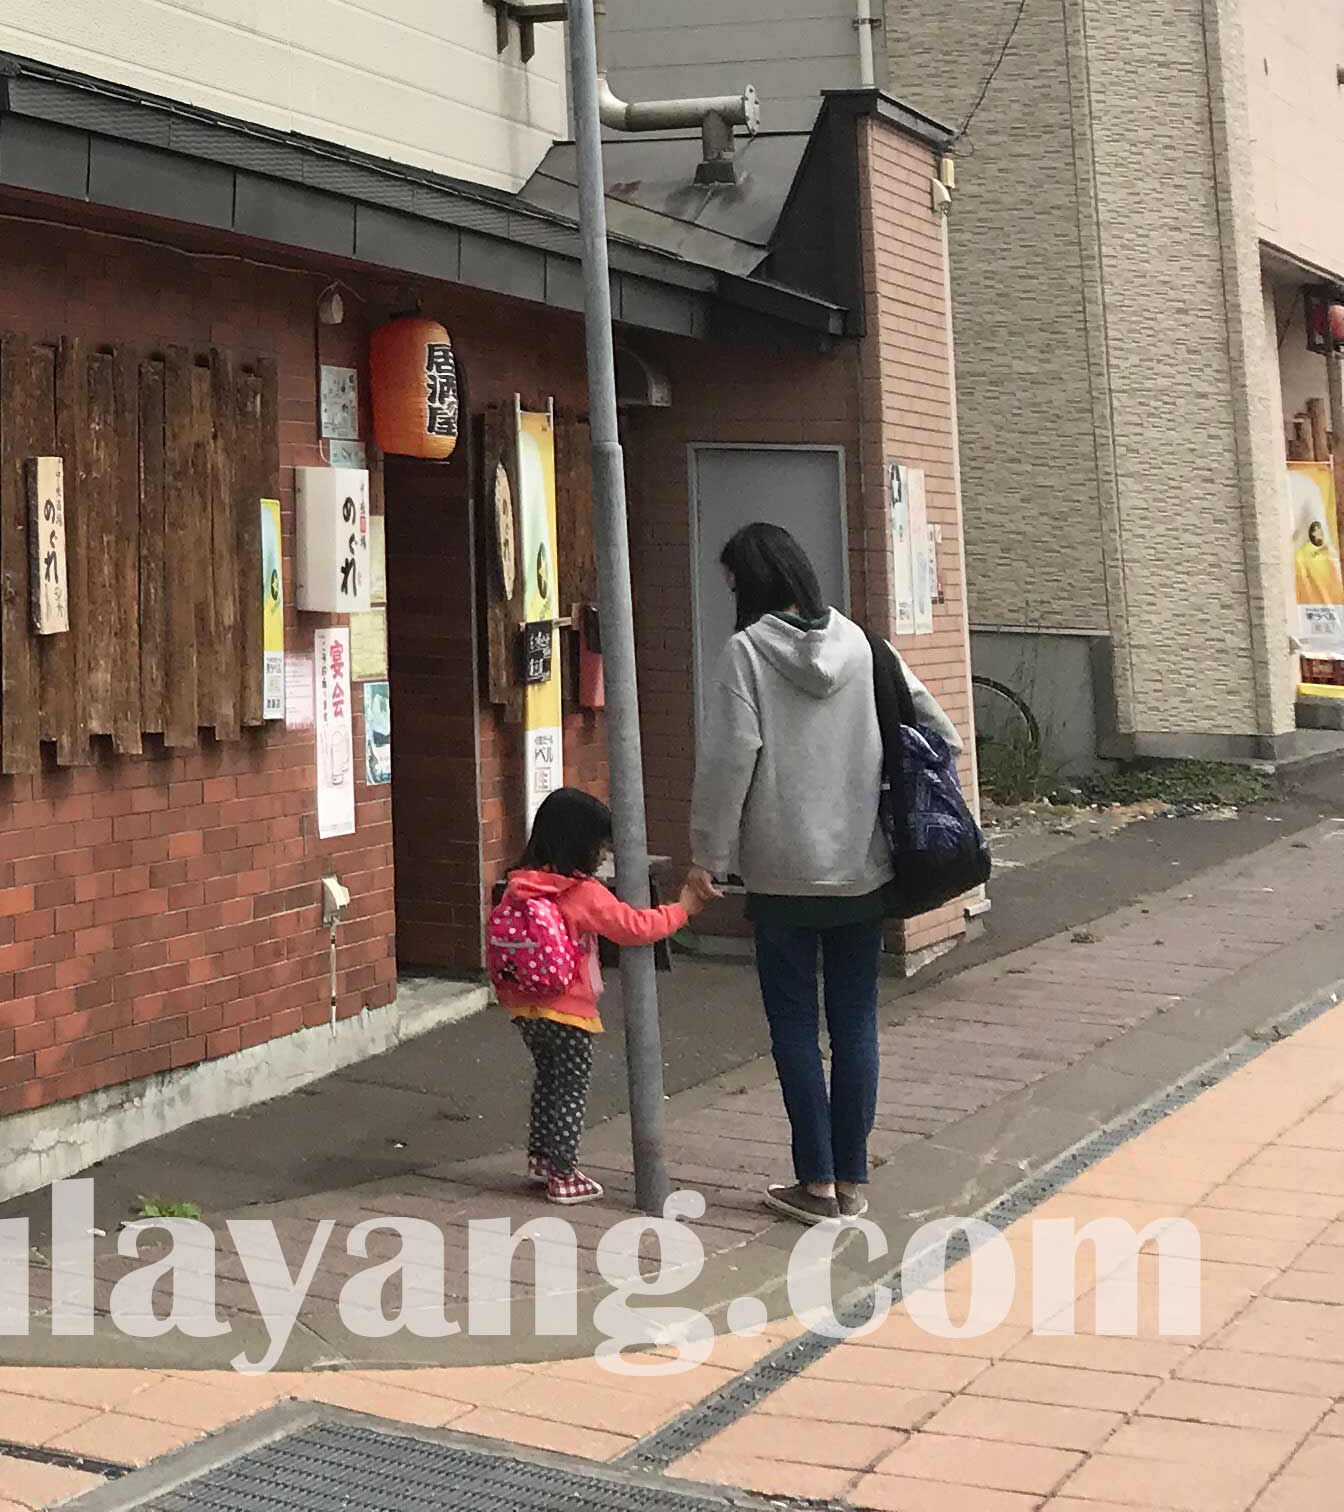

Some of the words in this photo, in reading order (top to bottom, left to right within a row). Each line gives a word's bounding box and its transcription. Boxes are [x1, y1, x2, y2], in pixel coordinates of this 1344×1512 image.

[424, 342, 459, 437] 居酒屋
[43, 499, 59, 585] めぐれ
[340, 496, 358, 597] めぐれ
[329, 640, 344, 718] 宴会
